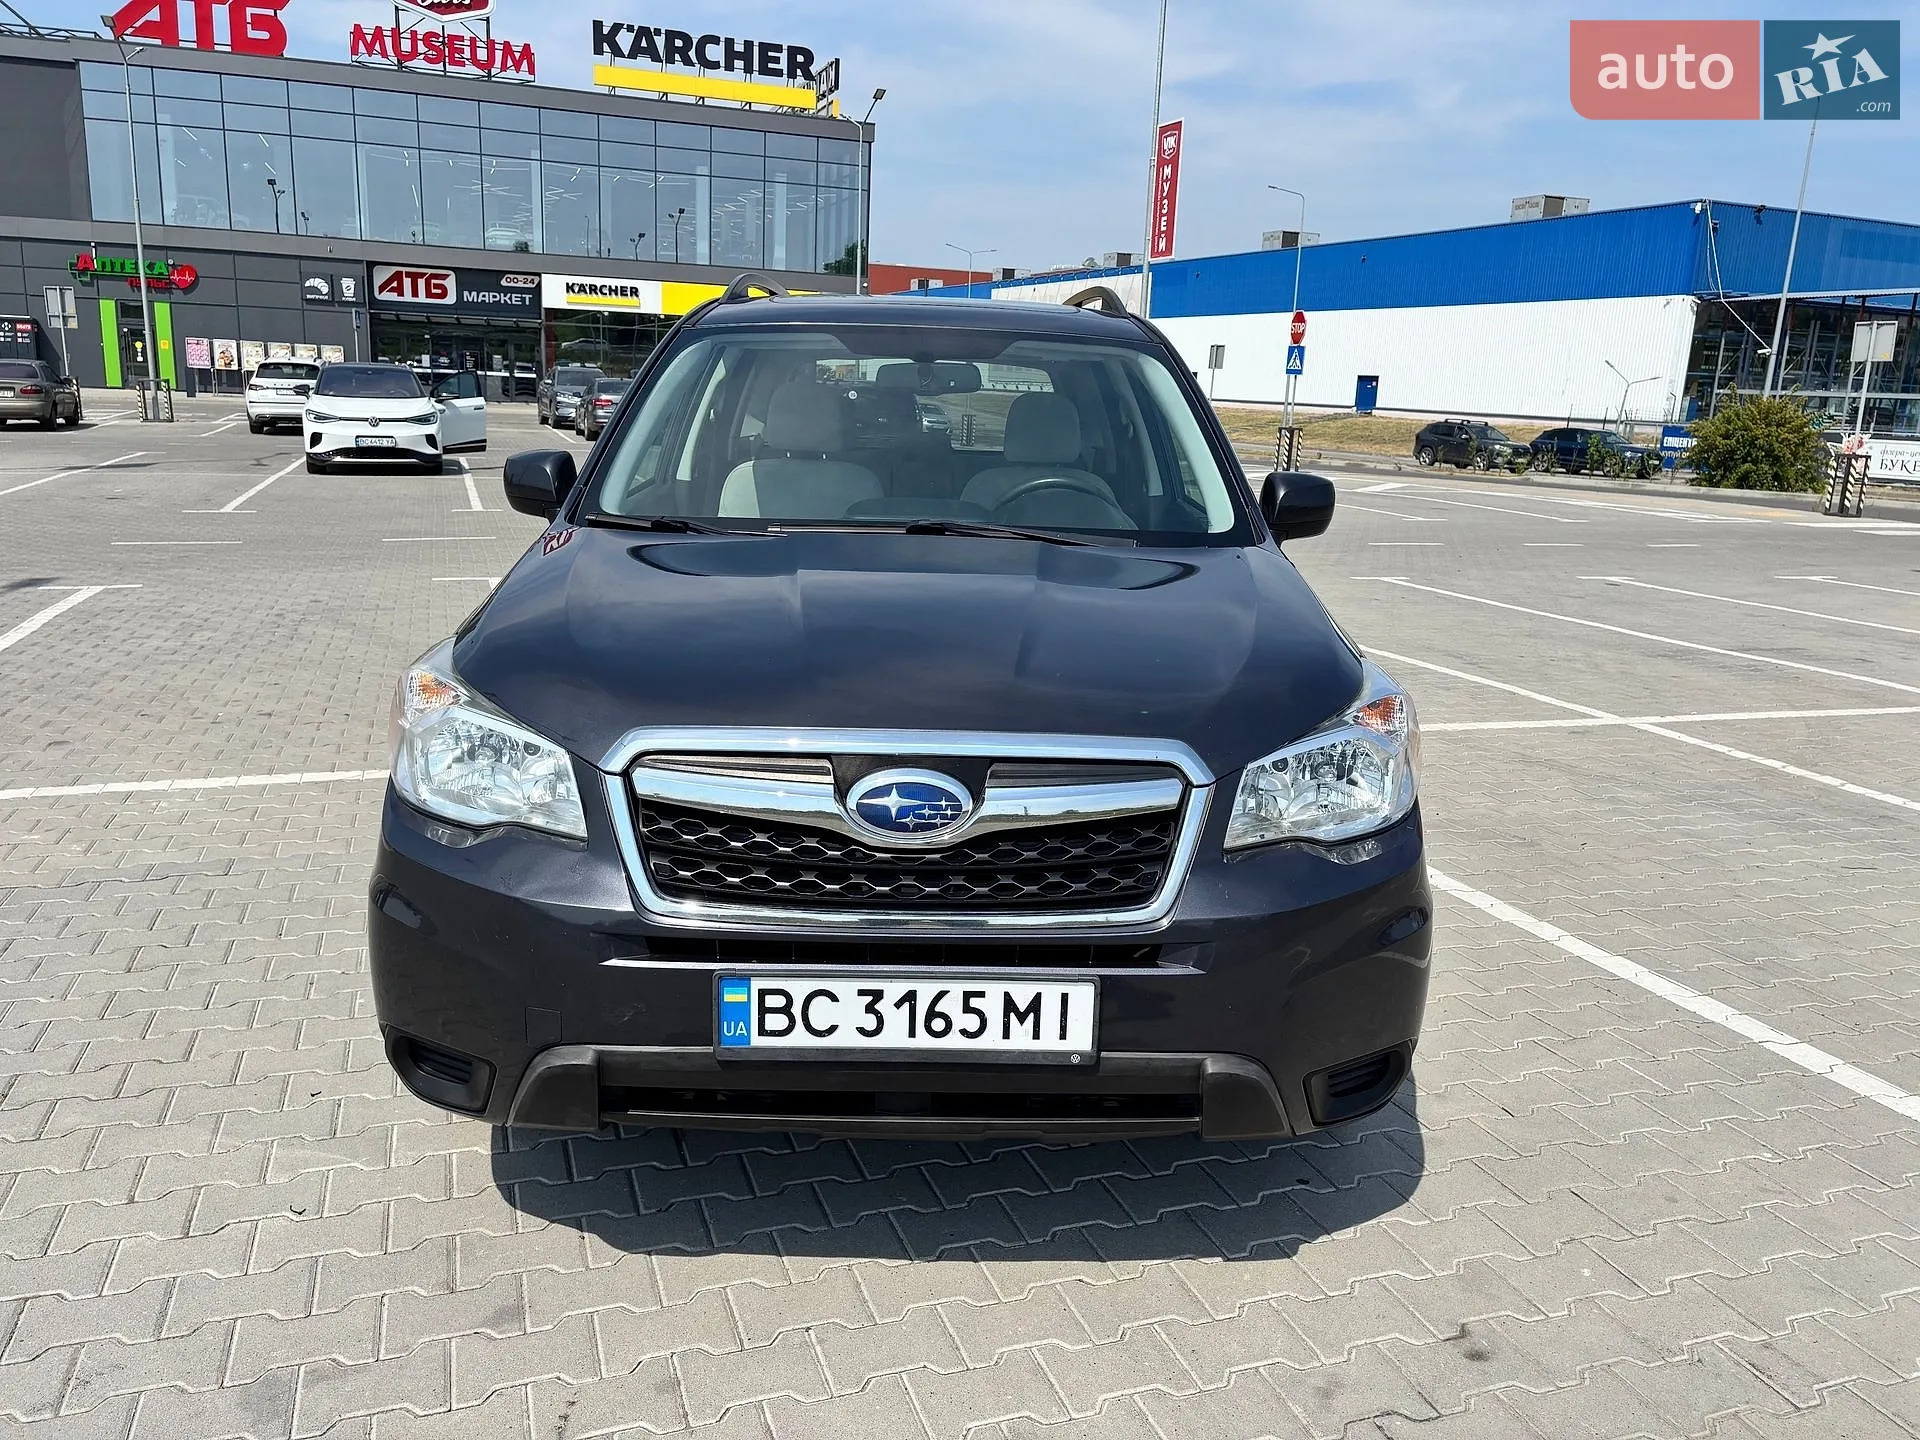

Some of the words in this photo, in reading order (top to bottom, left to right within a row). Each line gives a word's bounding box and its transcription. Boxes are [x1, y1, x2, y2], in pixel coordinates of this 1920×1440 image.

[351, 23, 535, 76] MUSEUM
[592, 19, 815, 82] KÄRCHER
[378, 270, 452, 300] АТБ
[504, 275, 536, 286] 00-24
[463, 290, 533, 305] МАРКЕТ
[565, 281, 640, 298] KÄRCHER
[1291, 322, 1306, 334] STOP
[757, 987, 840, 1038] BC
[855, 988, 988, 1040] 3165
[1002, 991, 1069, 1041] MI
[723, 1021, 748, 1038] UA
